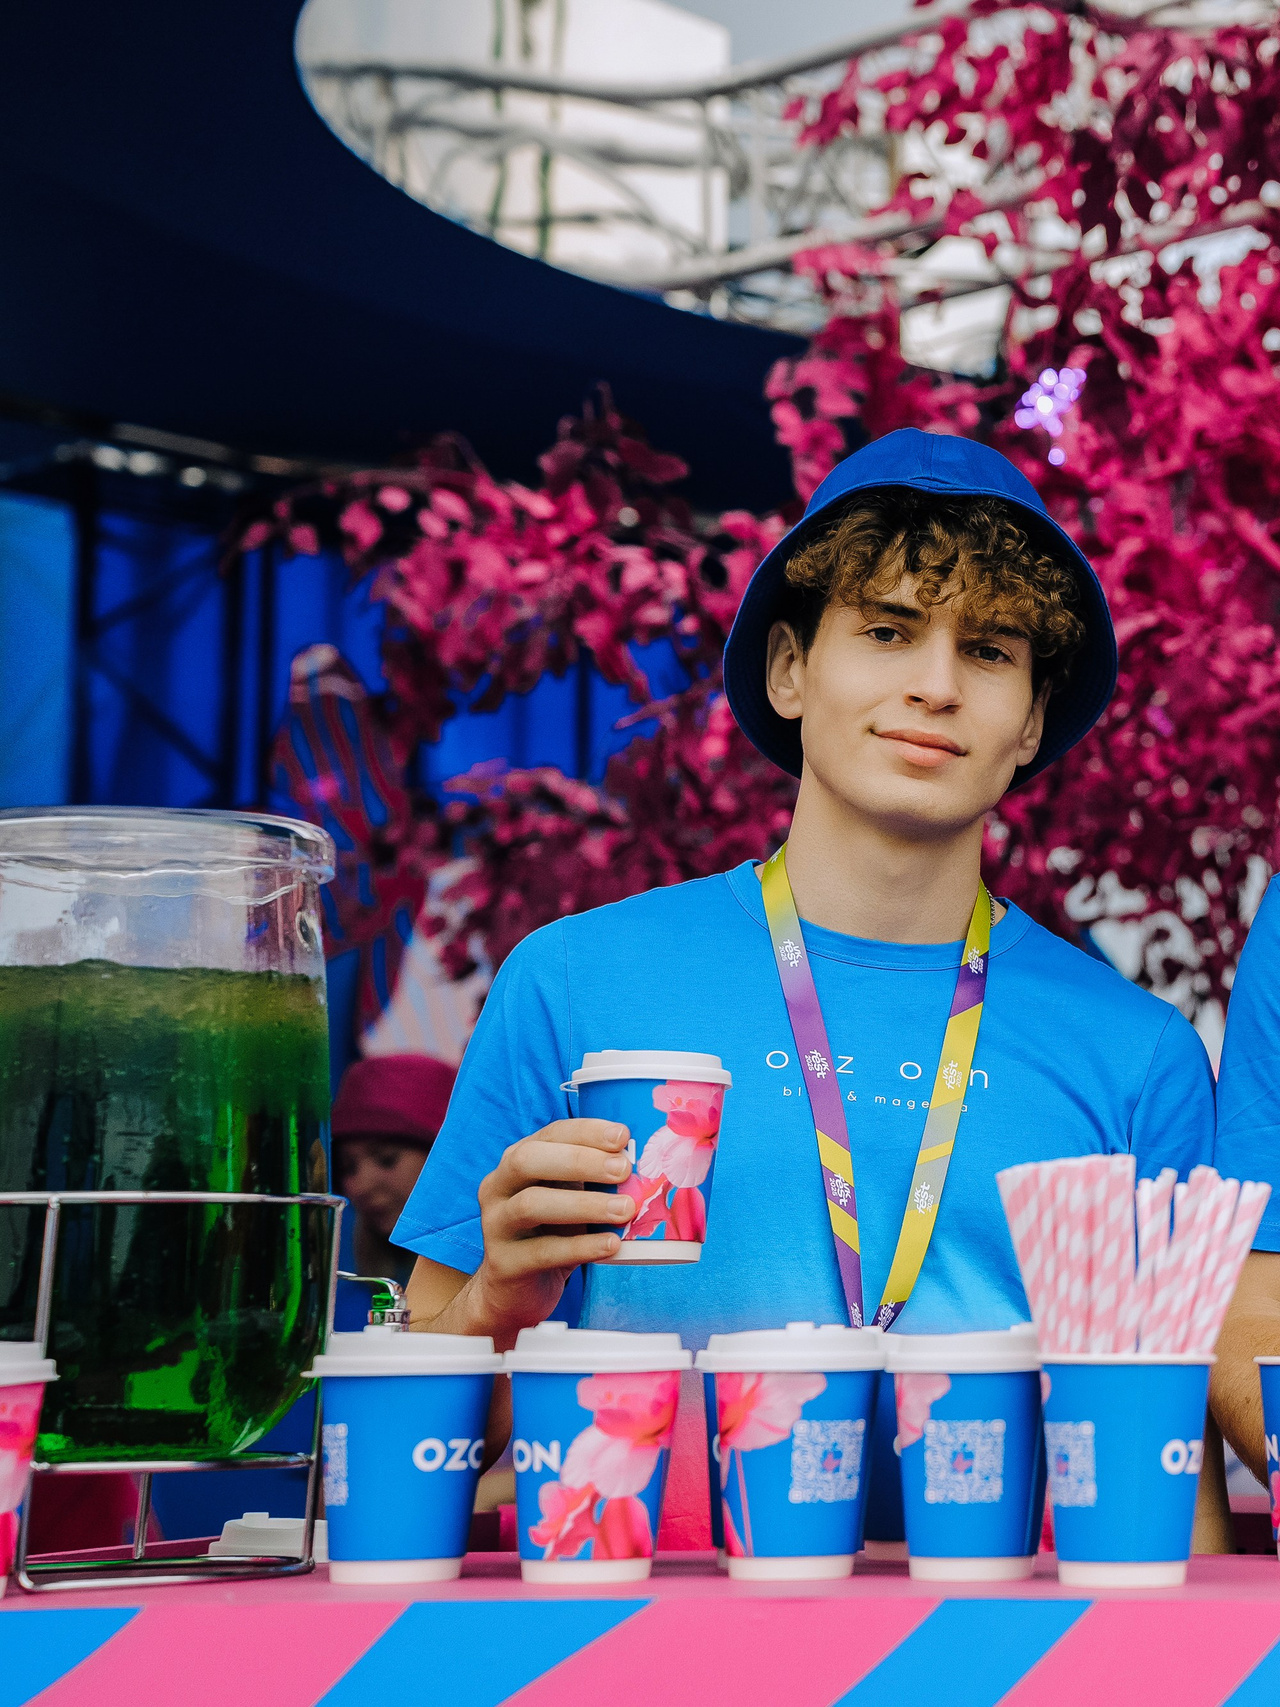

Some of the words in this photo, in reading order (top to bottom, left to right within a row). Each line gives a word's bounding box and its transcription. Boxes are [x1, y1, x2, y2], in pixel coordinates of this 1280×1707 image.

[783, 939, 799, 968] fest
[810, 1049, 827, 1079] fest
[945, 1060, 959, 1090] fest
[847, 1091, 857, 1102] &
[874, 1095, 968, 1113] magea
[917, 1181, 930, 1215] fest
